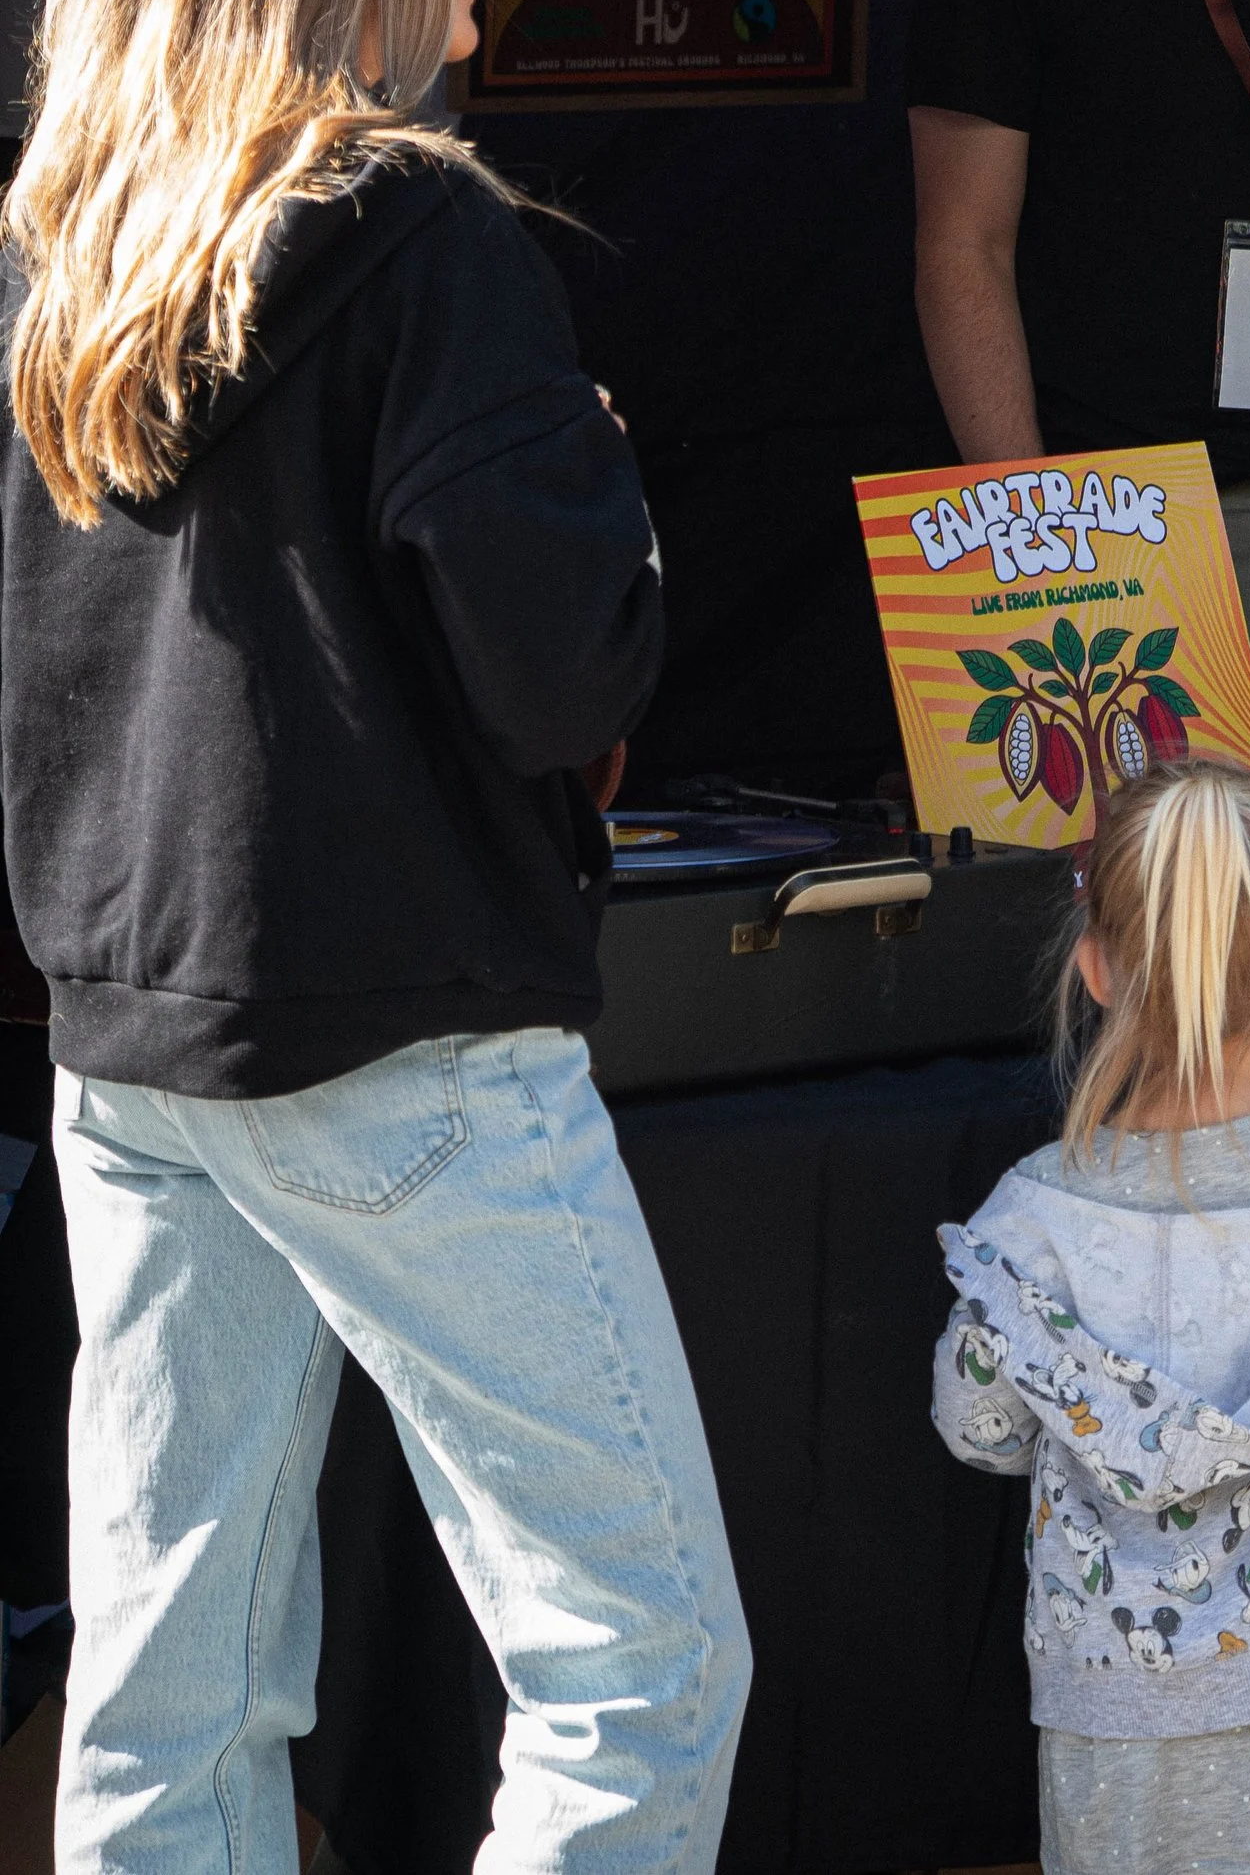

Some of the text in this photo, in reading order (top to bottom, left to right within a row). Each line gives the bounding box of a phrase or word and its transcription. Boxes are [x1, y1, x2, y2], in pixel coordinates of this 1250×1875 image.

[909, 470, 1168, 571] FAIRTRADE
[985, 513, 1102, 583] FEST
[972, 578, 1144, 616] LIVE FROM RICHMOND, VA
